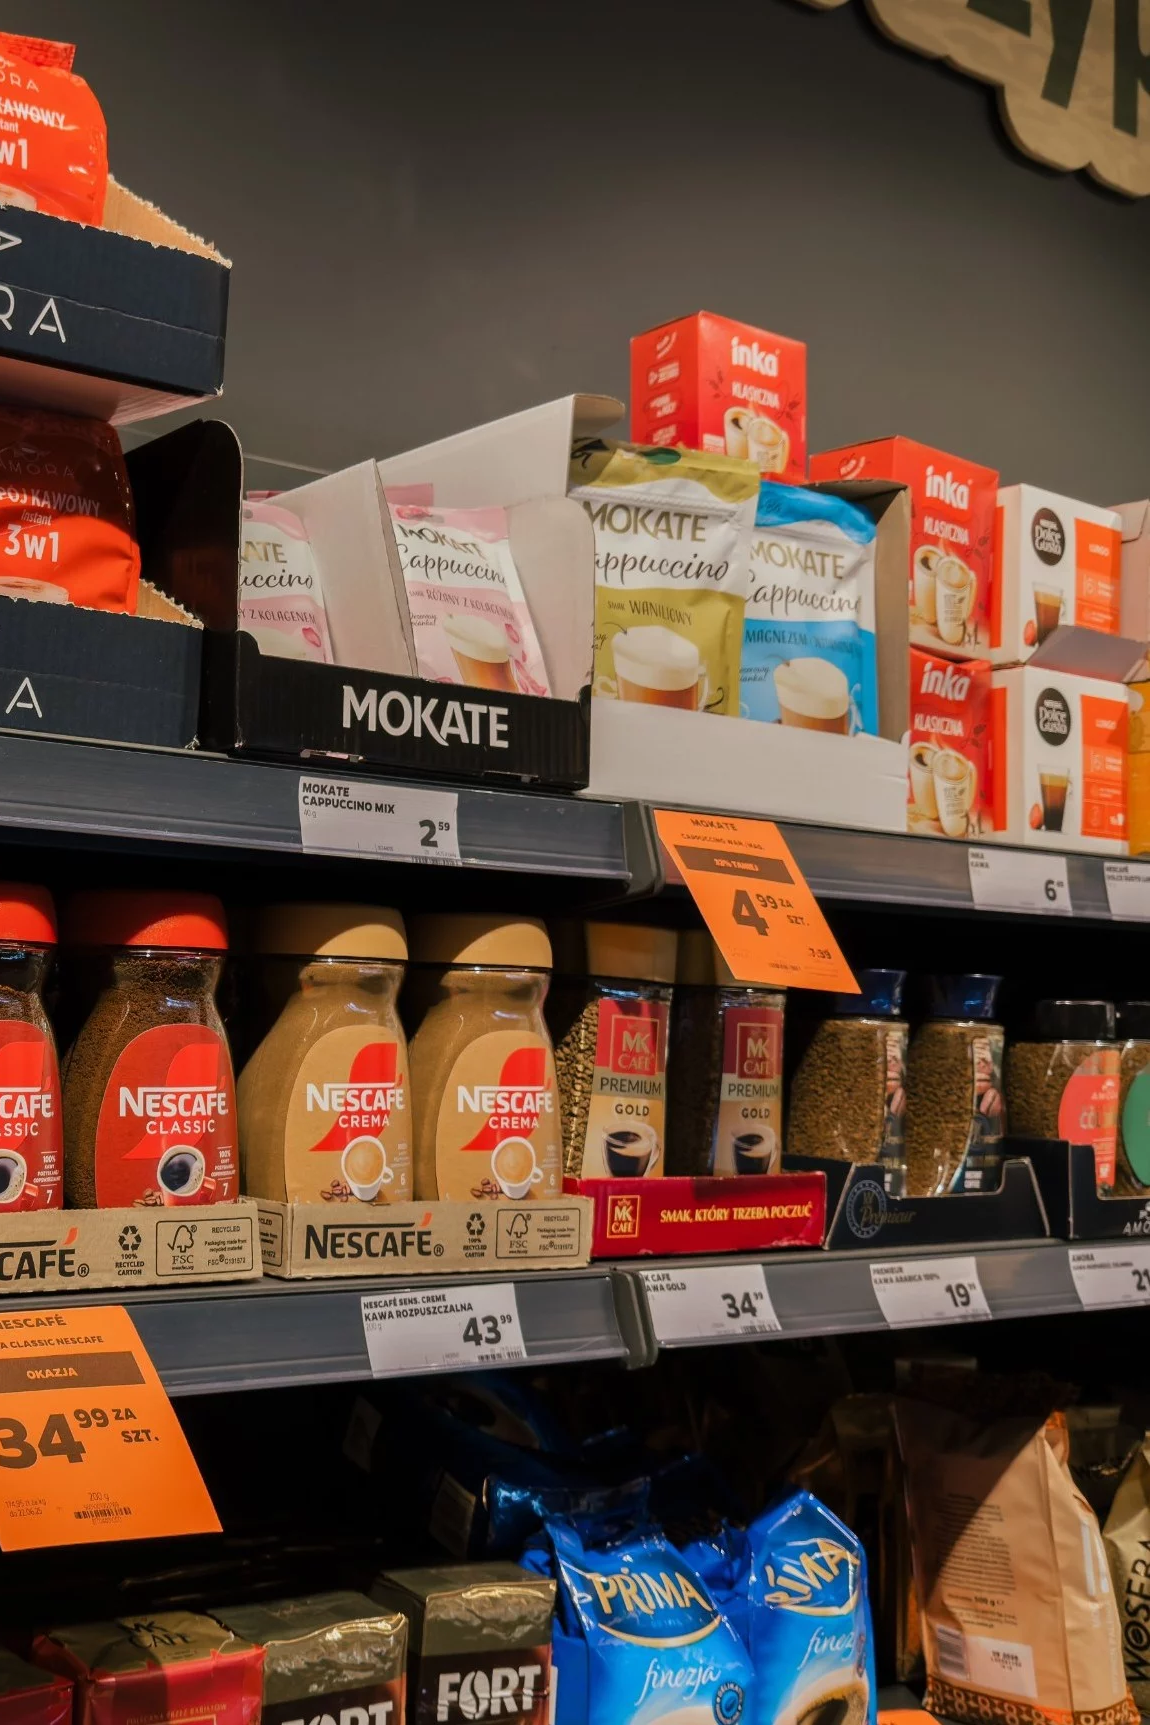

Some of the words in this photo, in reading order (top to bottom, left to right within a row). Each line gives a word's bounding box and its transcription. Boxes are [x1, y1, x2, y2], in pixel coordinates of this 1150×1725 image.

[731, 335, 781, 377] inka
[925, 464, 971, 510] inka
[31, 488, 100, 517] KAWOWY
[21, 509, 52, 526] instant
[582, 500, 708, 542] MOKATE
[397, 523, 484, 558] MOKATE
[750, 540, 846, 579] MOKATE
[628, 598, 693, 626] WANILIOWY
[921, 662, 971, 701] inka
[342, 685, 510, 749] MOKATE
[302, 782, 350, 798] MOKATE
[302, 796, 373, 812] CAPPUCCINO
[374, 804, 395, 814] MIX
[418, 819, 439, 848] 2
[438, 821, 450, 831] 59
[690, 818, 738, 832] MOKATE
[1044, 879, 1057, 901] 6
[732, 889, 770, 936] 4
[755, 893, 779, 910] 99
[621, 1030, 649, 1053] MK
[746, 1037, 771, 1058] MK
[600, 1077, 662, 1097] PREMIUM
[727, 1082, 780, 1099] PREMIUM
[614, 1103, 650, 1117] GOLD
[741, 1107, 770, 1119] GOLD
[146, 1120, 215, 1135] CLASSIC
[338, 1114, 390, 1129] CREMA
[488, 1116, 540, 1130] CREMA
[399, 1172, 407, 1186] 6
[549, 1173, 556, 1186] 6
[660, 1209, 692, 1223] SMAK,
[695, 1206, 731, 1222] KTÓRY
[732, 1206, 769, 1221] TRZEBA
[770, 1200, 814, 1219] POCZUĆ
[510, 1240, 528, 1249] FSC
[172, 1254, 194, 1265] FSC
[363, 1296, 398, 1310] NESCAFÉ
[399, 1297, 421, 1306] SENS.
[422, 1294, 447, 1304] CREME
[721, 1292, 757, 1319] 34
[945, 1283, 971, 1308] 19
[364, 1310, 394, 1322] KAWA
[396, 1303, 474, 1319] ROZPUSZCZALNA
[462, 1315, 501, 1346] 43
[500, 1314, 512, 1324] 99
[9, 1338, 55, 1350] CLASSIC
[56, 1335, 104, 1346] NESCAFE
[26, 1366, 78, 1381] OKAZJA
[72, 1408, 110, 1429] 99
[111, 1407, 137, 1421] ZA
[121, 1428, 159, 1444] SZT.
[588, 1567, 716, 1615] PRIMA
[634, 1657, 723, 1706] finezja
[437, 1664, 542, 1722] FORT
